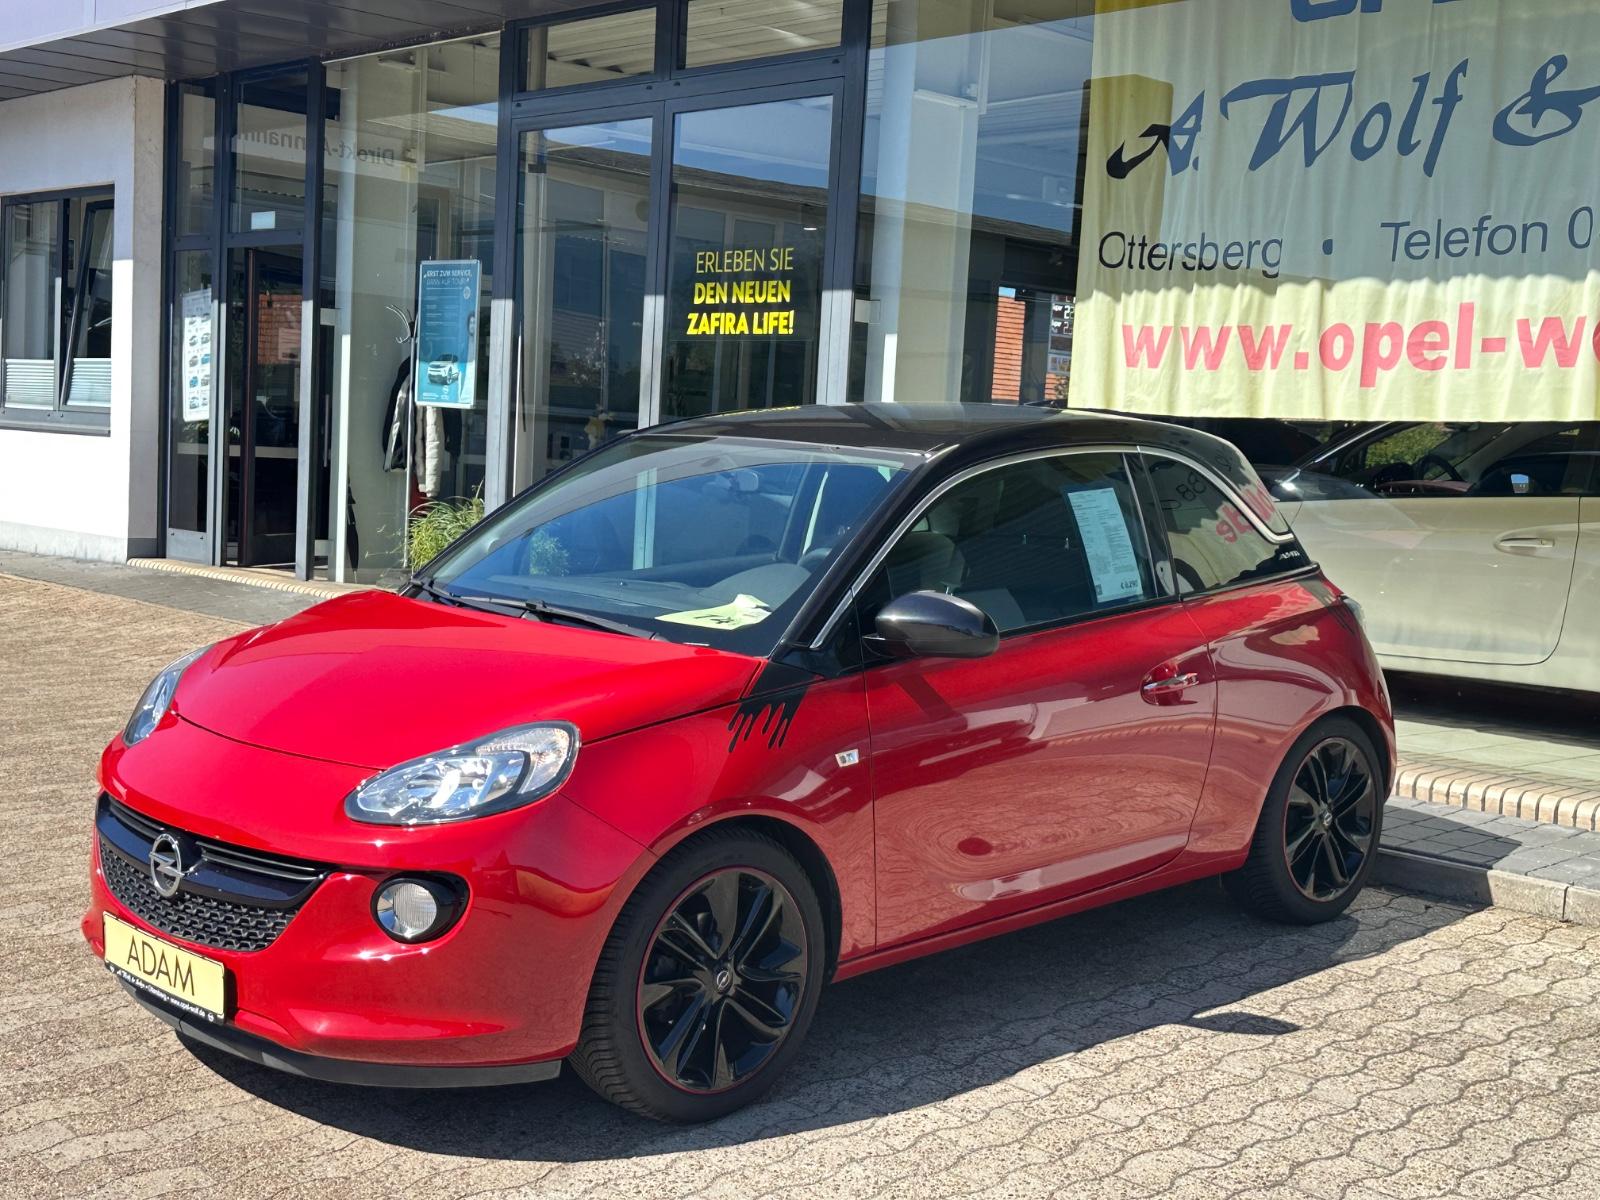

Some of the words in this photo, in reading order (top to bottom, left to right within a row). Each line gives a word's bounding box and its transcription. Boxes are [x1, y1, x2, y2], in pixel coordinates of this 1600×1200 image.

[1106, 89, 1205, 179] A.
[1220, 58, 1469, 178] Wolf
[1493, 54, 1600, 147] &
[695, 249, 765, 273] ERLEBEN
[769, 247, 794, 271] SIE
[1098, 231, 1283, 279] Ottersberg
[1380, 214, 1548, 262] Telefon
[686, 311, 750, 335] ZAFIRA
[752, 310, 795, 335] LIFE!
[693, 281, 728, 304] DEN
[731, 280, 791, 303] NEUEN
[1122, 302, 1600, 388] www.opel-w
[127, 934, 195, 997] ADAM
